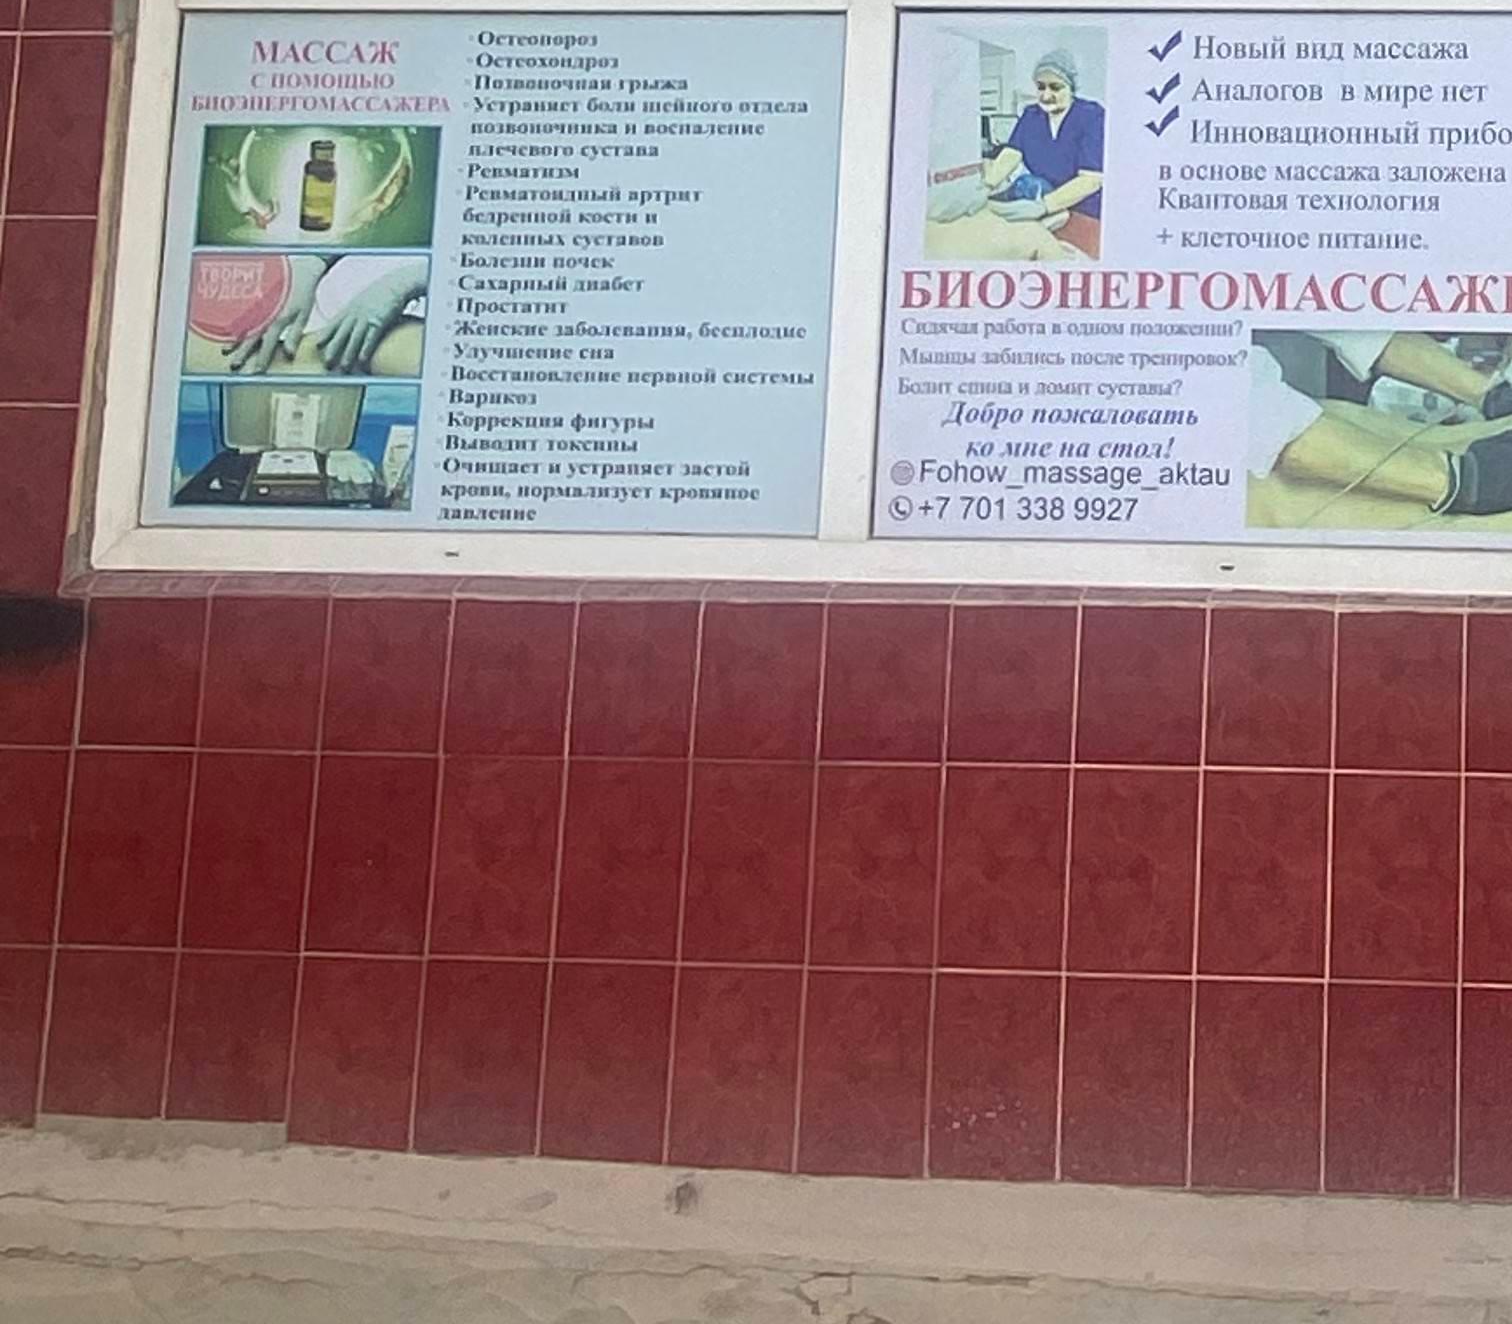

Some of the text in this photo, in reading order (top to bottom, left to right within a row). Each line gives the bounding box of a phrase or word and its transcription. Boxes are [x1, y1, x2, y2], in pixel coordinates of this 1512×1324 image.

[477, 31, 598, 50] Остеопороз
[1193, 35, 1469, 61] Новый вид массажа
[253, 41, 399, 64] МАССАЖ
[476, 52, 619, 72] Остеохондроз
[251, 73, 394, 90] С ПОМОЩЬЮ
[474, 75, 688, 94] Позвоночная грыжа
[1192, 79, 1488, 108] Аналогов в мире нет
[191, 95, 451, 112] БИОЭНЕРГОМАССАЖЕРА
[473, 97, 808, 116] Устраняет боли шейного отдела
[471, 122, 765, 138] позвоночника и воспаление
[1190, 119, 1419, 147] Инновационный
[468, 144, 659, 160] плечевого сустава
[467, 164, 580, 179] Ревматизм
[1158, 165, 1507, 183] в основе массажа заложена
[465, 184, 702, 206] Ревматоидный артрит
[1158, 188, 1440, 211] Квантовая технология
[463, 209, 657, 227] бедренной кости и
[461, 234, 664, 250] коленных суставов
[1181, 231, 1309, 249] клеточное
[1318, 233, 1429, 250] питание.
[459, 253, 615, 269] Болезни почек
[458, 275, 644, 294] Сахарный диабет
[456, 298, 568, 316] Простатит
[453, 320, 548, 337] Женские
[699, 322, 807, 339] бесплодие
[900, 318, 1243, 339] Сидячая работа в одном положении?
[453, 344, 614, 362] Улучшение сна
[899, 348, 1247, 369] Мышцы забились после тренировок?
[451, 366, 815, 387] Восстановление нервной системы
[449, 388, 537, 407] Варикоз
[898, 377, 1183, 399] Болит спина и ломит суставы?
[447, 411, 654, 433] Коррекция фигуры
[940, 402, 1199, 430] Добро пожаловать
[445, 435, 638, 452] Выводит токсины
[966, 437, 1176, 459] ко мне на стол!
[442, 458, 751, 479] Очищает и устраняет застой
[920, 459, 1230, 491] Fohow_massage_aktau
[517, 486, 652, 502] нормализует
[660, 488, 760, 503] кровяное
[436, 508, 537, 521] давление
[918, 496, 1138, 521] +7 701 338 9927
